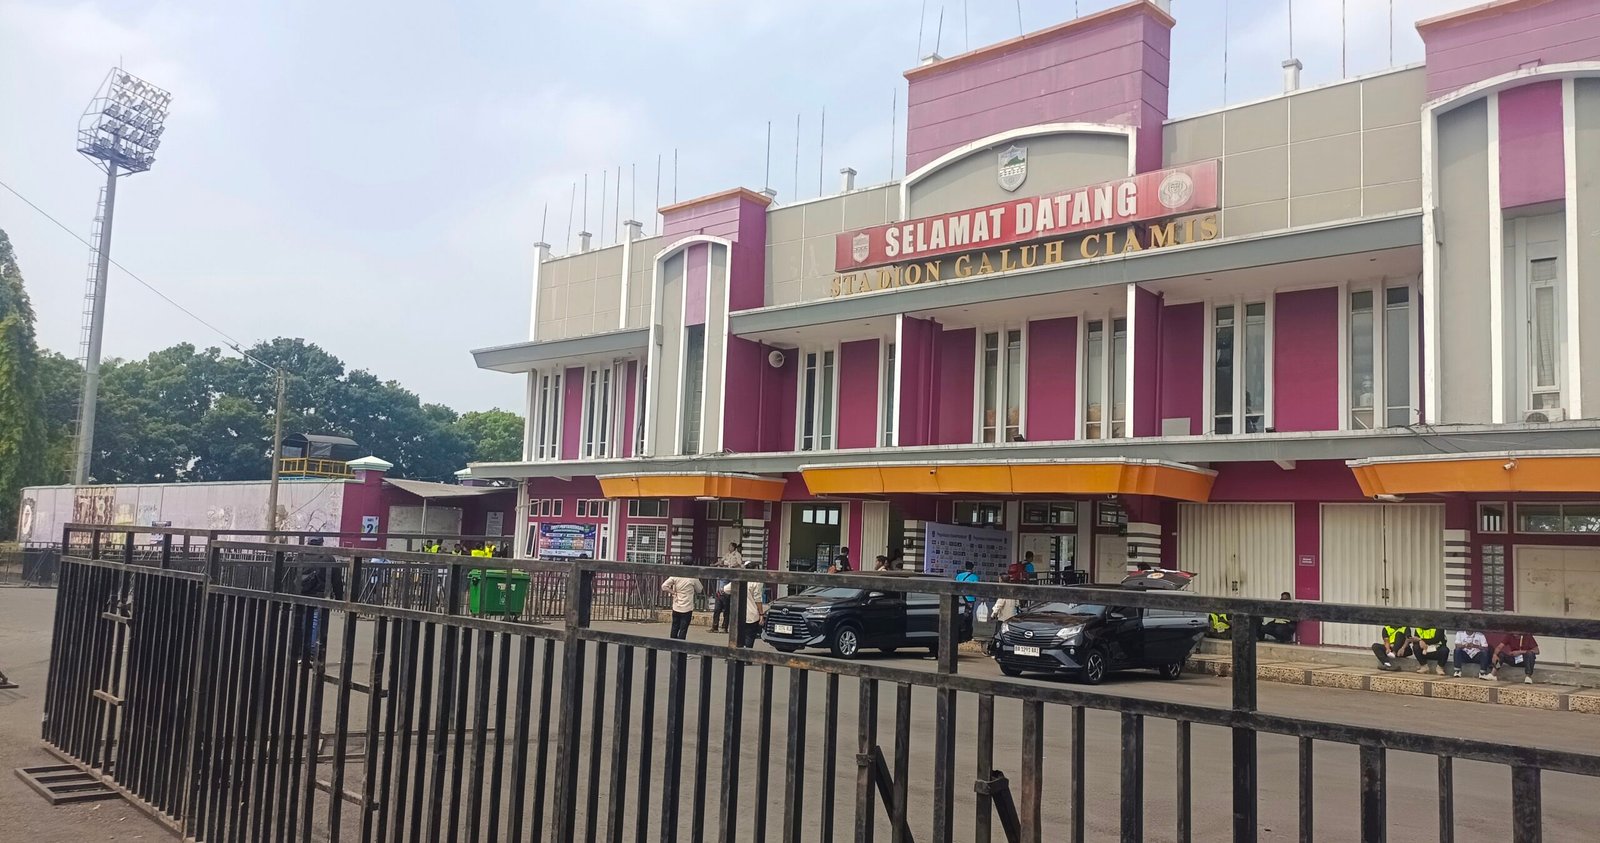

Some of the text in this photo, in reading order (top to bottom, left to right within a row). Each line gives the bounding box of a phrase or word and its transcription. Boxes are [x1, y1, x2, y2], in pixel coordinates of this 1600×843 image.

[831, 214, 1218, 297] STADION GALUH CIAMIS
[885, 208, 1005, 257] SELAMAT
[1017, 182, 1137, 234] DATANG
